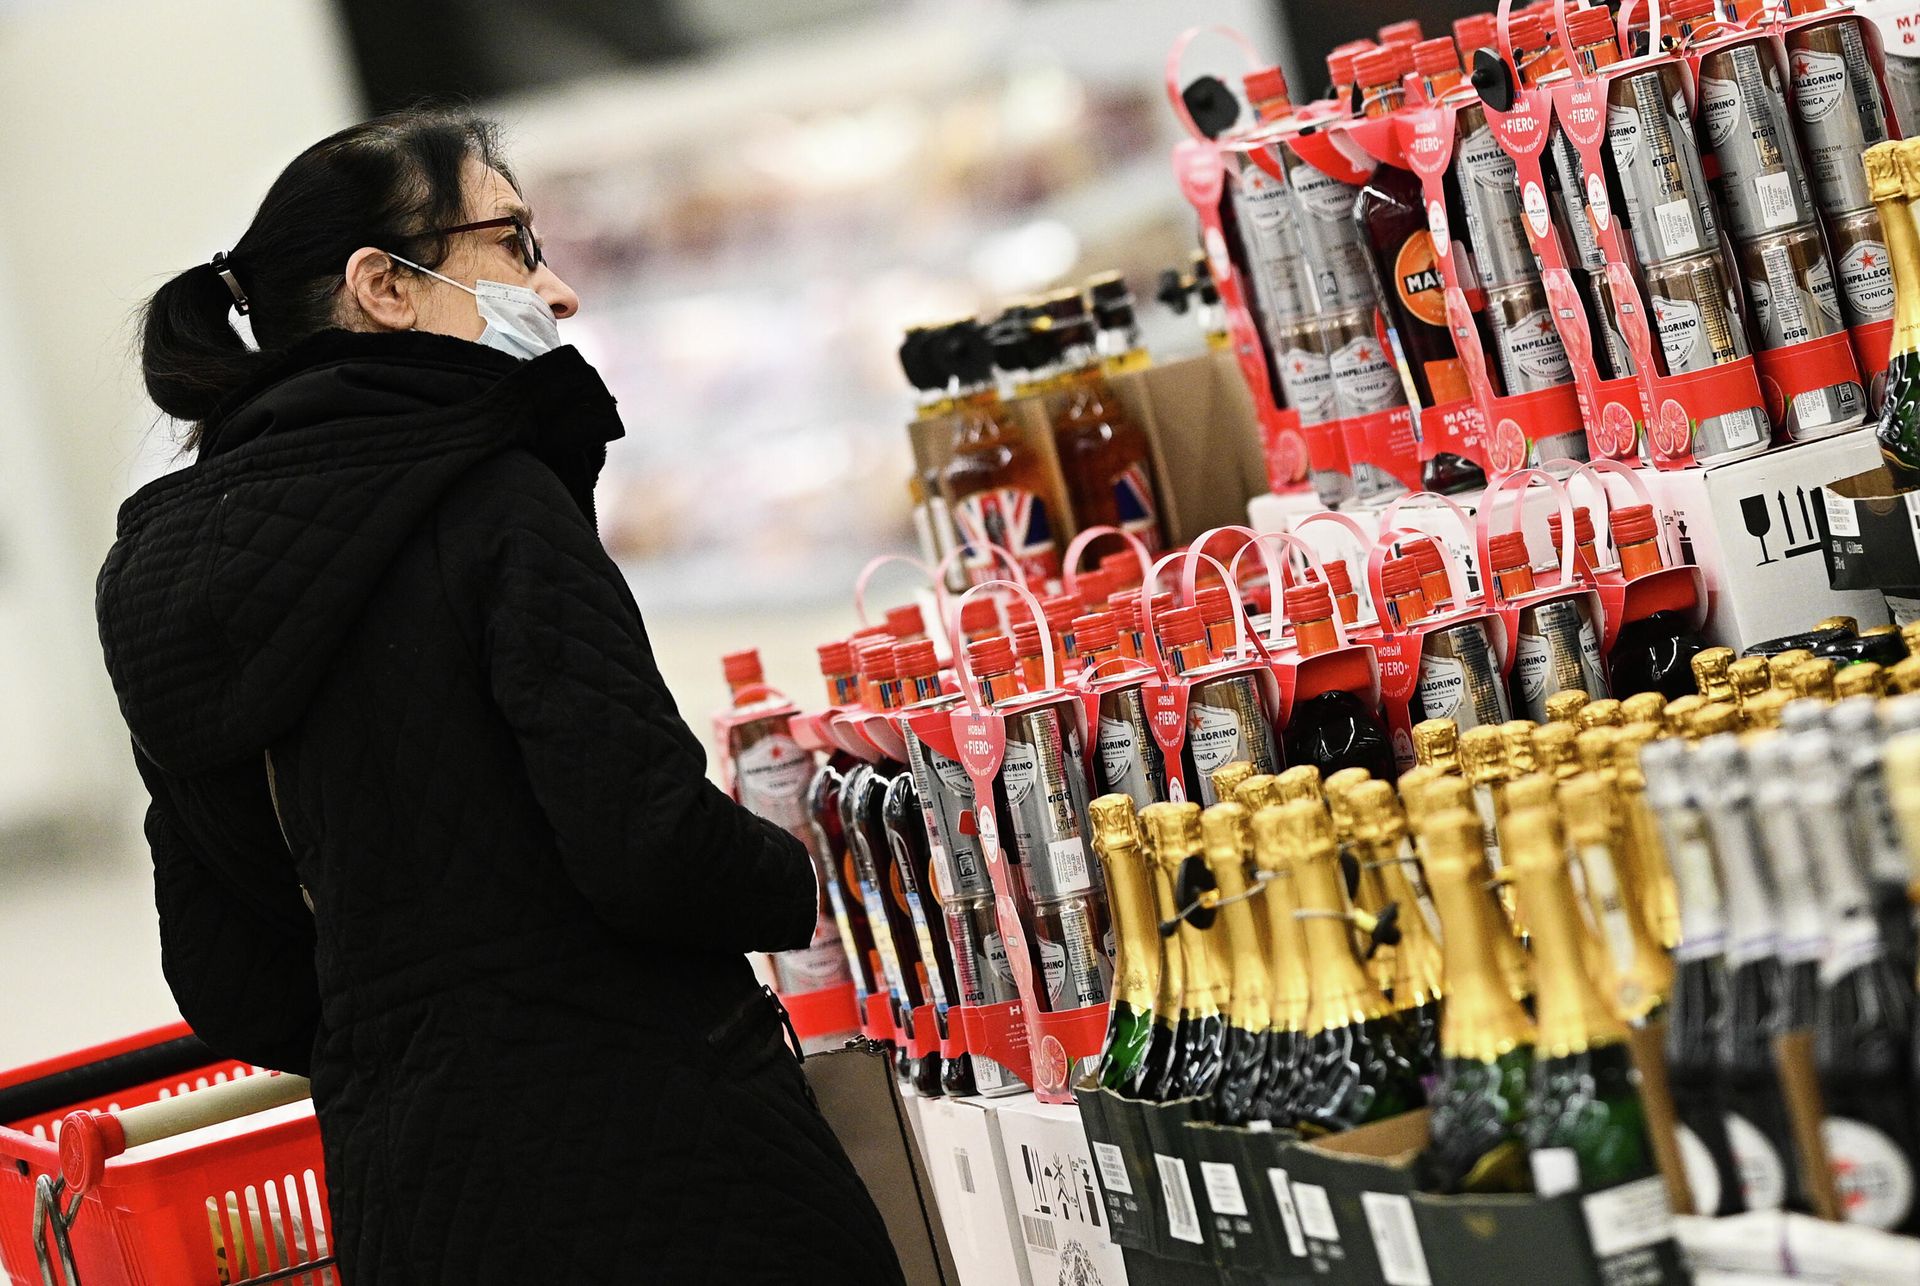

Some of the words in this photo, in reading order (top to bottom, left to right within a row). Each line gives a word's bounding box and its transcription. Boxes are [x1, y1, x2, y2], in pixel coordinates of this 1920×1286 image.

[1896, 14, 1920, 30] MA
[1903, 33, 1915, 44] &
[1507, 116, 1534, 134] FIERO
[1414, 136, 1440, 154] FIERO
[1859, 287, 1894, 301] TONICA
[1378, 642, 1401, 657] НОВЫЙ
[1379, 661, 1405, 677] FIERO
[1158, 711, 1177, 726] FIERO
[967, 721, 987, 736] НОВЫЙ
[968, 740, 989, 755] FIERO
